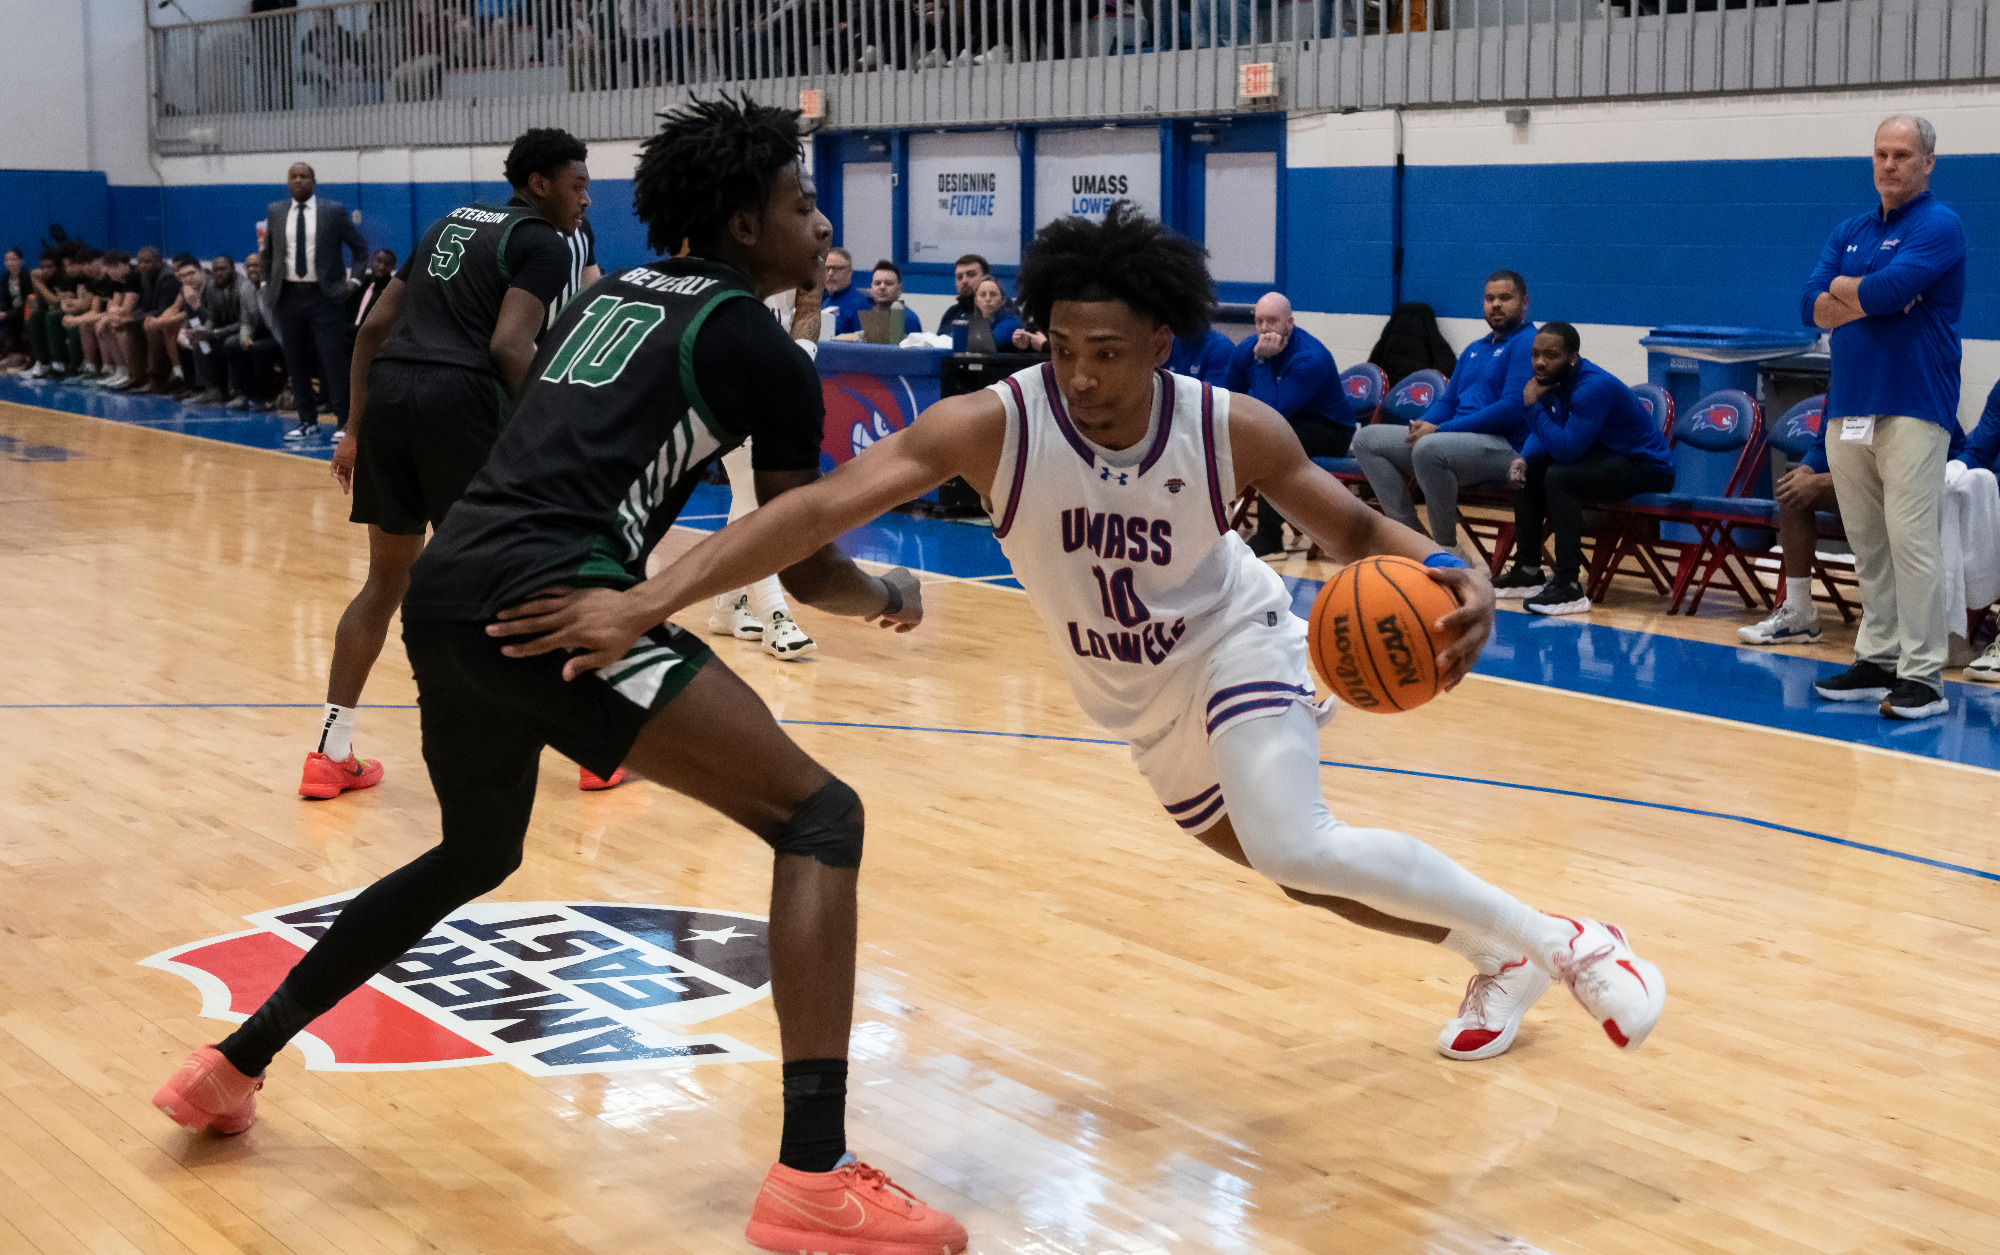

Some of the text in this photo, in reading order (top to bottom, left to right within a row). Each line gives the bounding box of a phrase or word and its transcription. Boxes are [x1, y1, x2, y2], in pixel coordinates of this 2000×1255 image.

[1245, 65, 1269, 94] EXIT
[938, 173, 996, 193] DESIGNING
[949, 194, 995, 216] FUTURE
[1072, 175, 1128, 194] UMASS
[1072, 197, 1116, 214] LOWE
[427, 223, 477, 281] 5
[619, 266, 720, 296] BEVERLY
[540, 294, 666, 388] 10
[1061, 506, 1172, 566] UMASS
[1092, 565, 1151, 628] 10
[1333, 612, 1380, 709] Wilson
[1376, 613, 1420, 689] NCAA
[444, 913, 731, 1012] EAST
